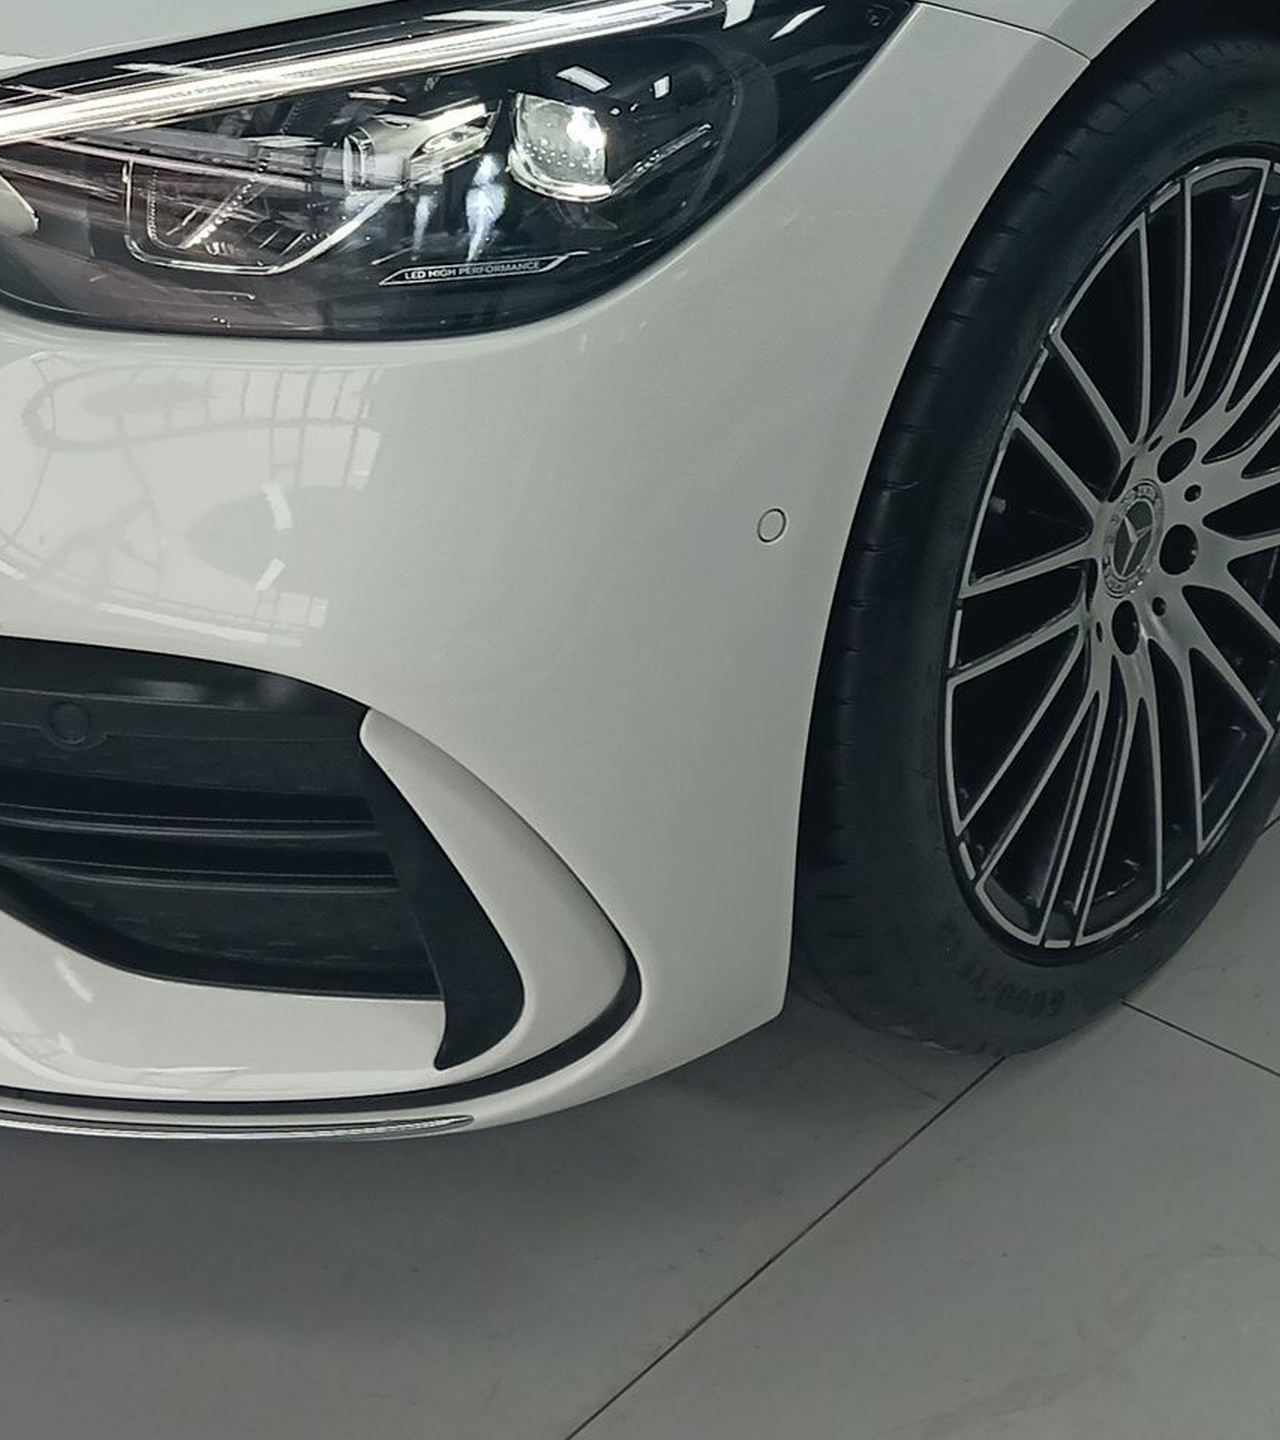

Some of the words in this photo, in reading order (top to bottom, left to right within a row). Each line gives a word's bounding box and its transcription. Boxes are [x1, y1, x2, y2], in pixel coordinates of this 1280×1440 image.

[405, 271, 426, 280] LED
[428, 269, 457, 279] HIGH
[458, 261, 541, 276] PERFORMANCE
